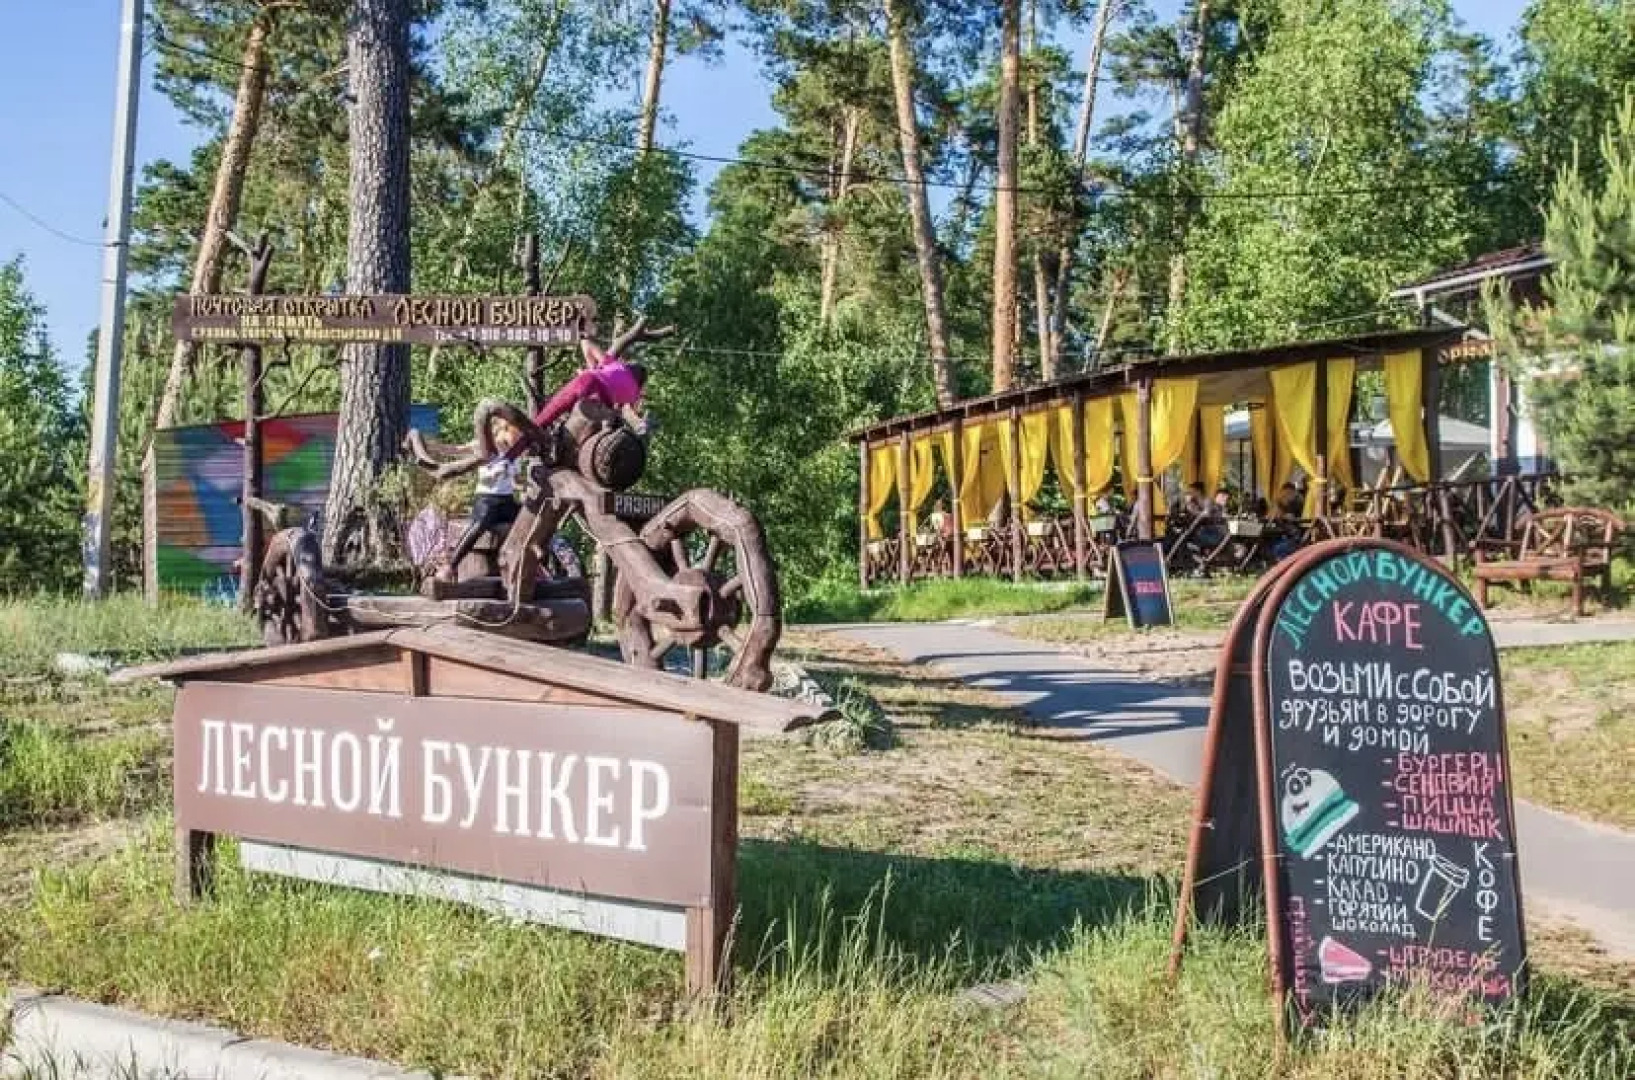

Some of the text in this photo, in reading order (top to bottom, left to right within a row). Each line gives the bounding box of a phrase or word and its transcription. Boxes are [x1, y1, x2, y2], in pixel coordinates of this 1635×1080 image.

[1277, 549, 1485, 650] ЛЕСНОЙ БУНКЕР
[1332, 600, 1423, 649] КАФЕ
[1288, 658, 1393, 700] ВОЗЬМИ
[198, 718, 671, 851] ЛЕСНОЙ БУНКЕР
[1473, 840, 1499, 941] КОФЕ
